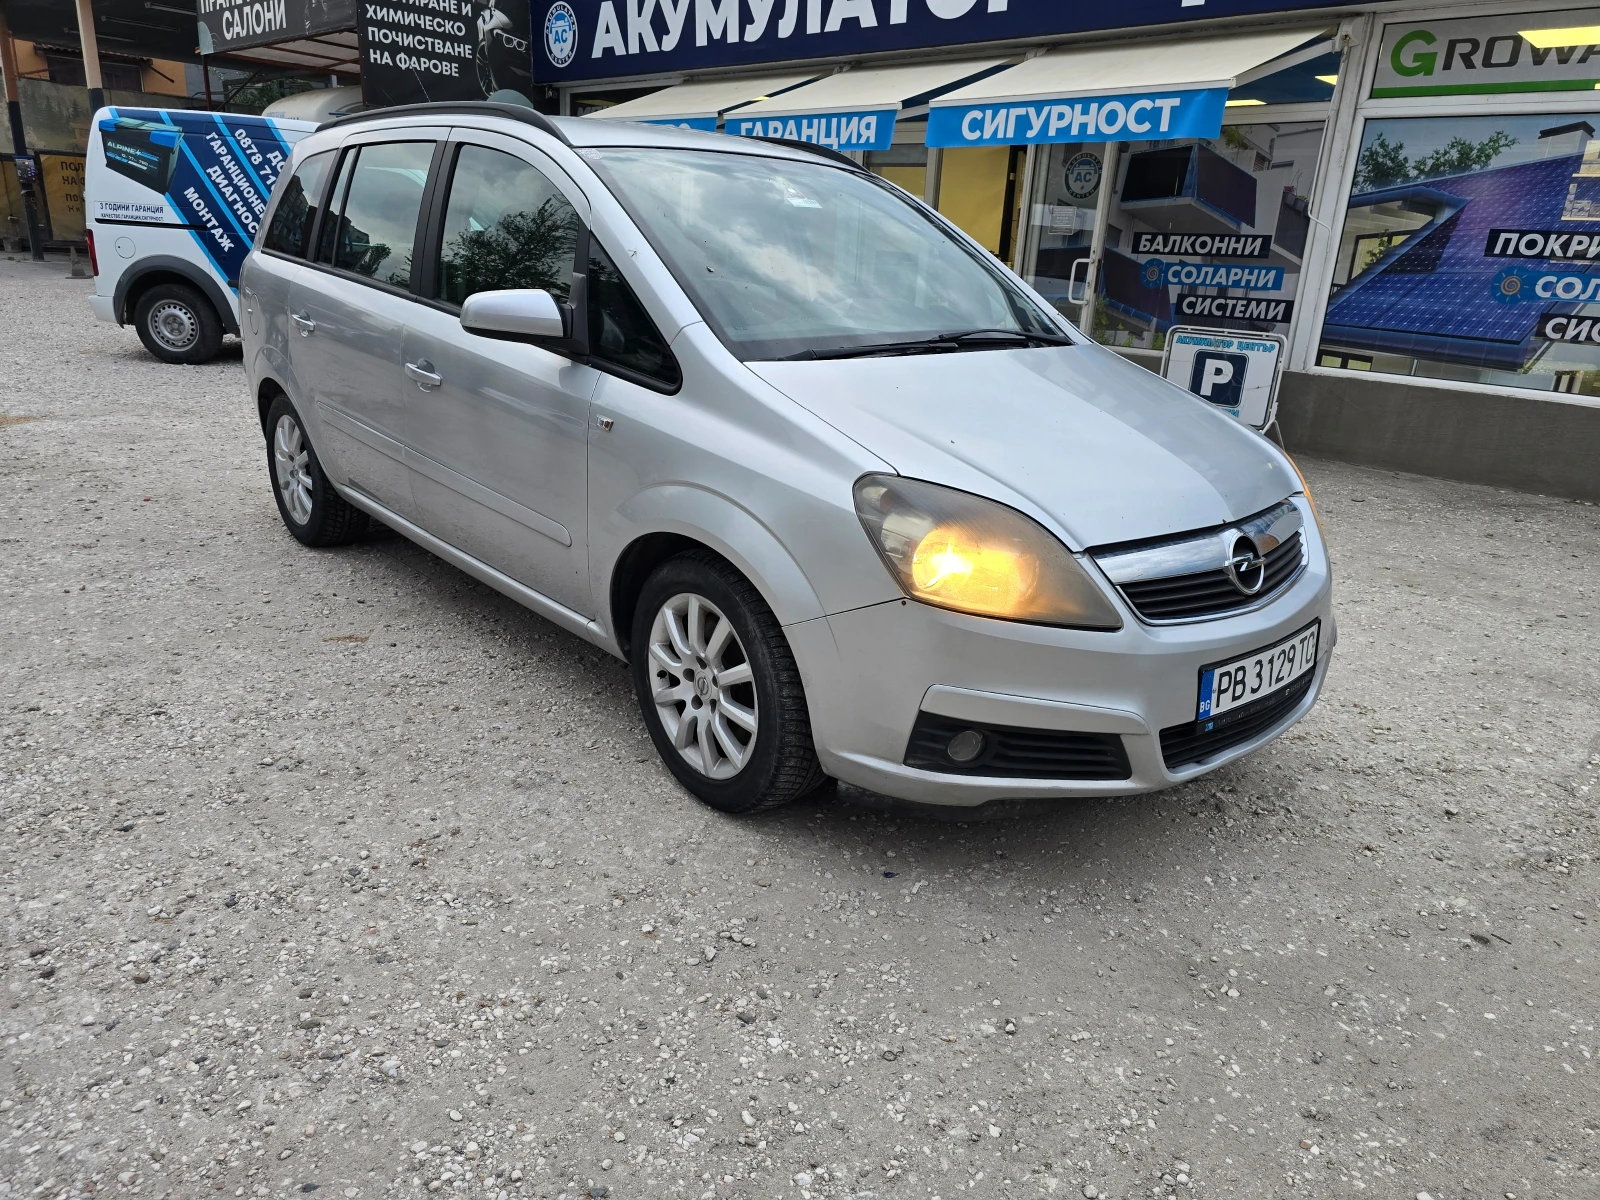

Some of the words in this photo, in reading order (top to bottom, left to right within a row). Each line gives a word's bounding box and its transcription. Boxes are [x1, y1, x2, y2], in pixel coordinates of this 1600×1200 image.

[222, 0, 287, 40] САЛОНИ
[365, 3, 466, 36] ХИМИЧЕСКО
[461, 2, 472, 17] И
[367, 26, 473, 59] ПОЧИСТВАНЕ
[553, 28, 568, 44] AC
[591, 0, 1007, 58] АКУМУЛА
[369, 48, 394, 67] НА
[395, 51, 460, 77] ФАРОВЕ
[961, 97, 1181, 141] СИГУРНОСТ
[234, 128, 263, 165] 0878
[205, 131, 267, 219] ГАРАНЦИОНЕ
[1073, 171, 1092, 183] AC
[105, 202, 130, 212] ГОДИНИ
[131, 204, 164, 214] ГАРАНЦИЯ
[183, 186, 235, 253] МОНТАЖ
[1138, 234, 1263, 256] БАЛКОННИ
[1167, 265, 1277, 288] СОЛАРНИ
[1181, 296, 1286, 321] СИСТЕМИ
[1236, 341, 1276, 353] ЦЕНТЪР
[1200, 358, 1234, 397] P
[1215, 664, 1247, 709] PB
[1250, 643, 1296, 695] 3129
[1199, 699, 1211, 713] BG
